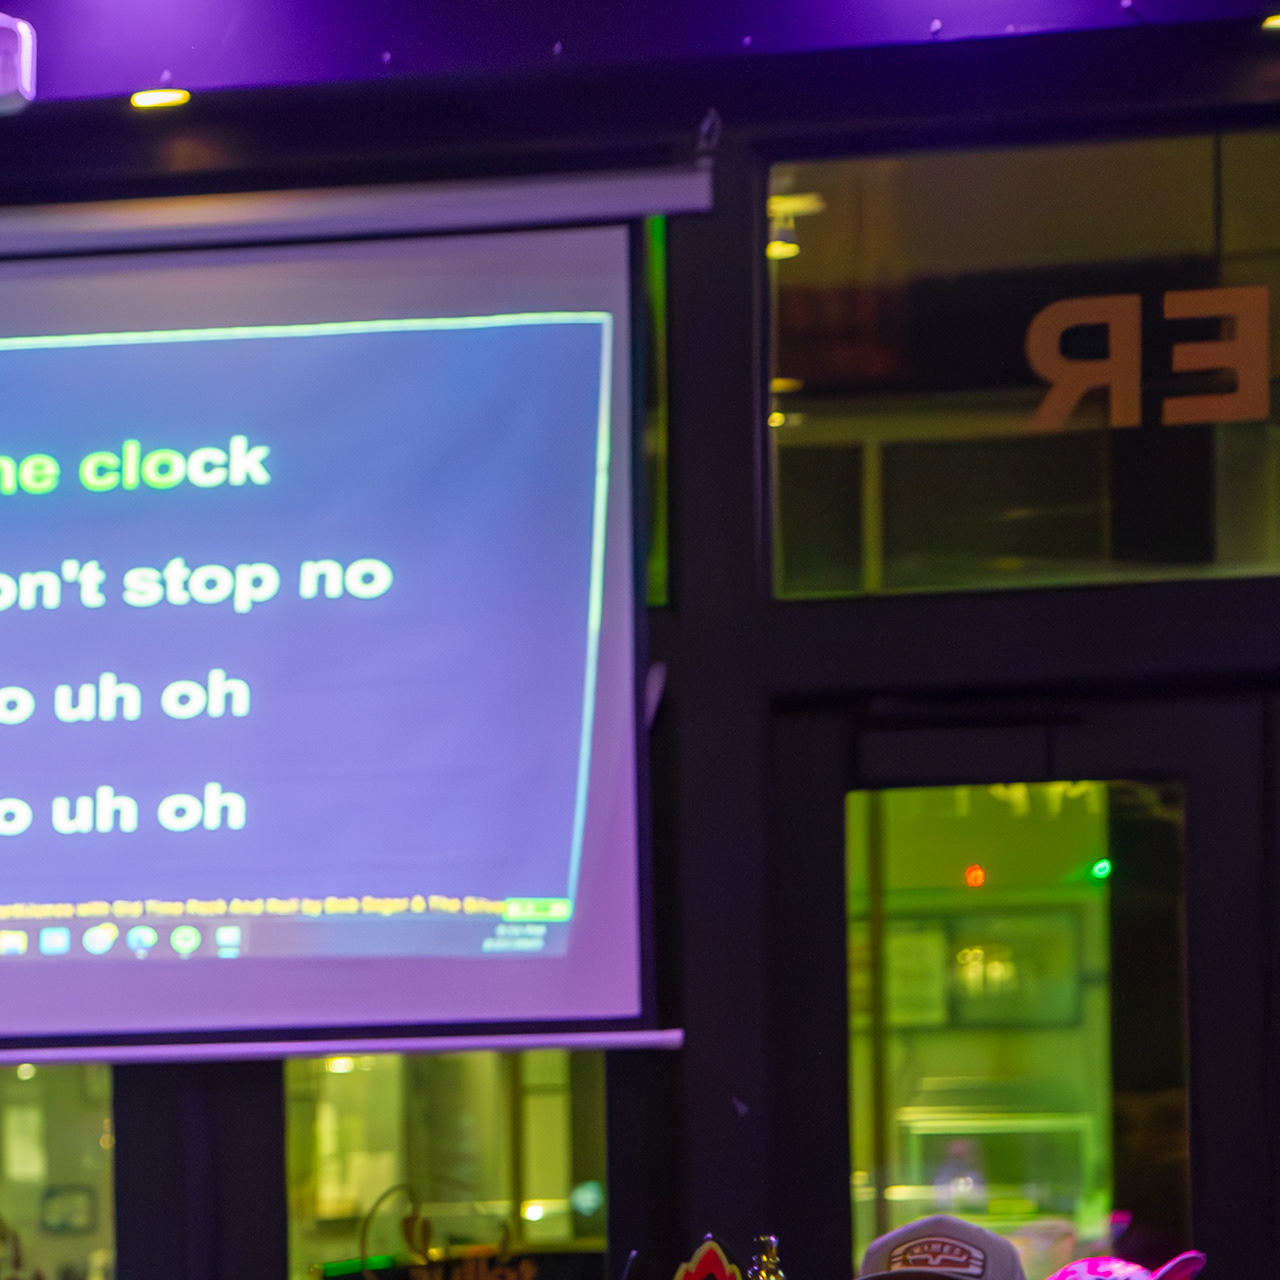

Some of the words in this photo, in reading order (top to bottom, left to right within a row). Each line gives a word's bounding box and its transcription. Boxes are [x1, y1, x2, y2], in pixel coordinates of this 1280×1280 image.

[77, 433, 272, 494] clock
[121, 556, 282, 615] stop
[298, 557, 395, 600] no
[53, 670, 143, 724] uh
[159, 667, 252, 721] oh
[50, 784, 140, 836] uh
[156, 780, 248, 833] oh
